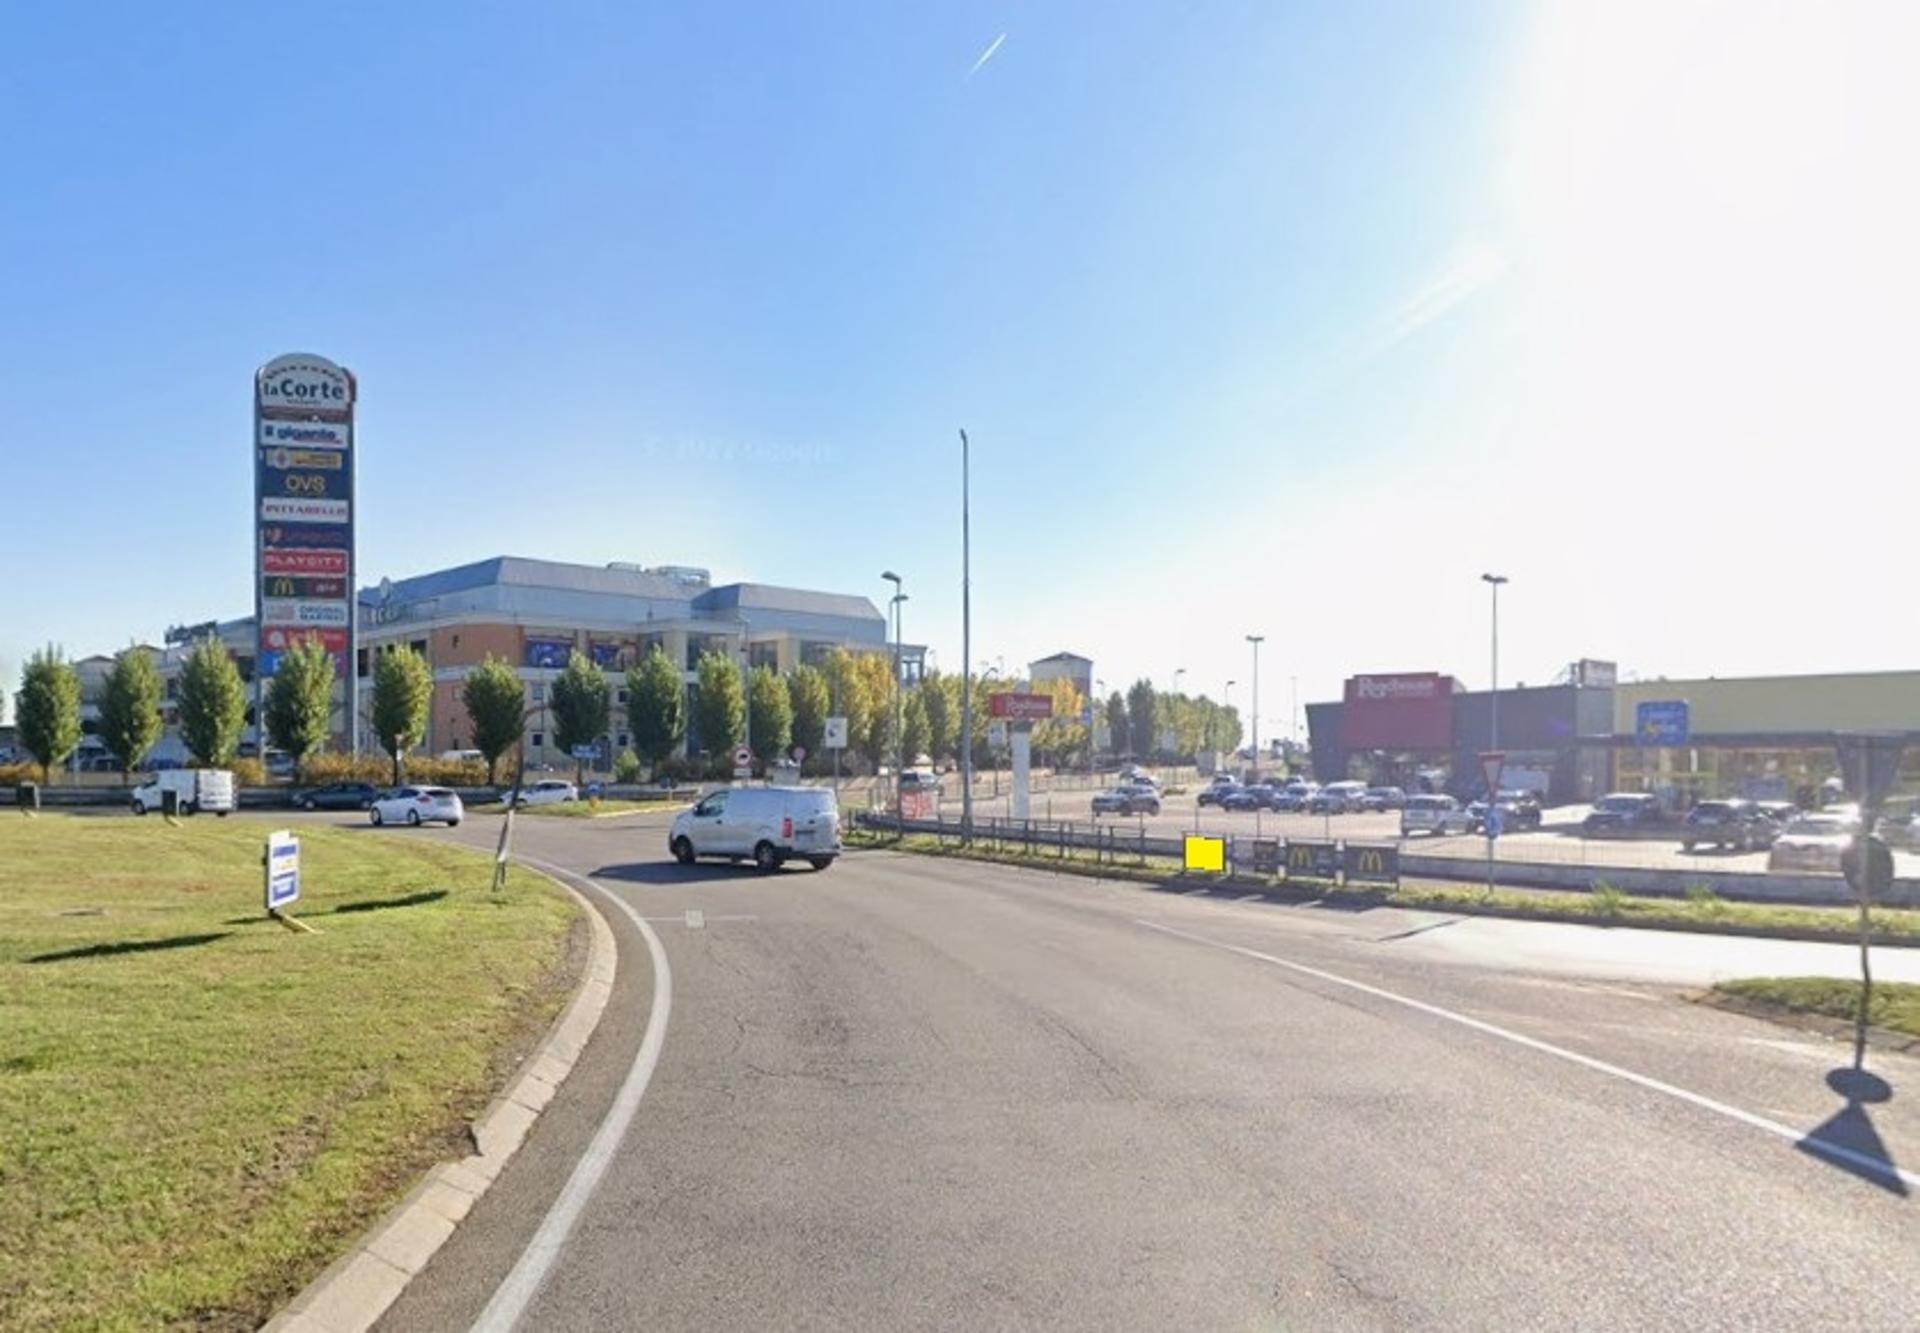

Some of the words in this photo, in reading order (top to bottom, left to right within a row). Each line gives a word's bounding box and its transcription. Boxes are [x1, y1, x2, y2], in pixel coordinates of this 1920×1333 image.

[263, 382, 278, 395] la
[280, 379, 344, 399] Corte
[286, 474, 325, 492] OVS
